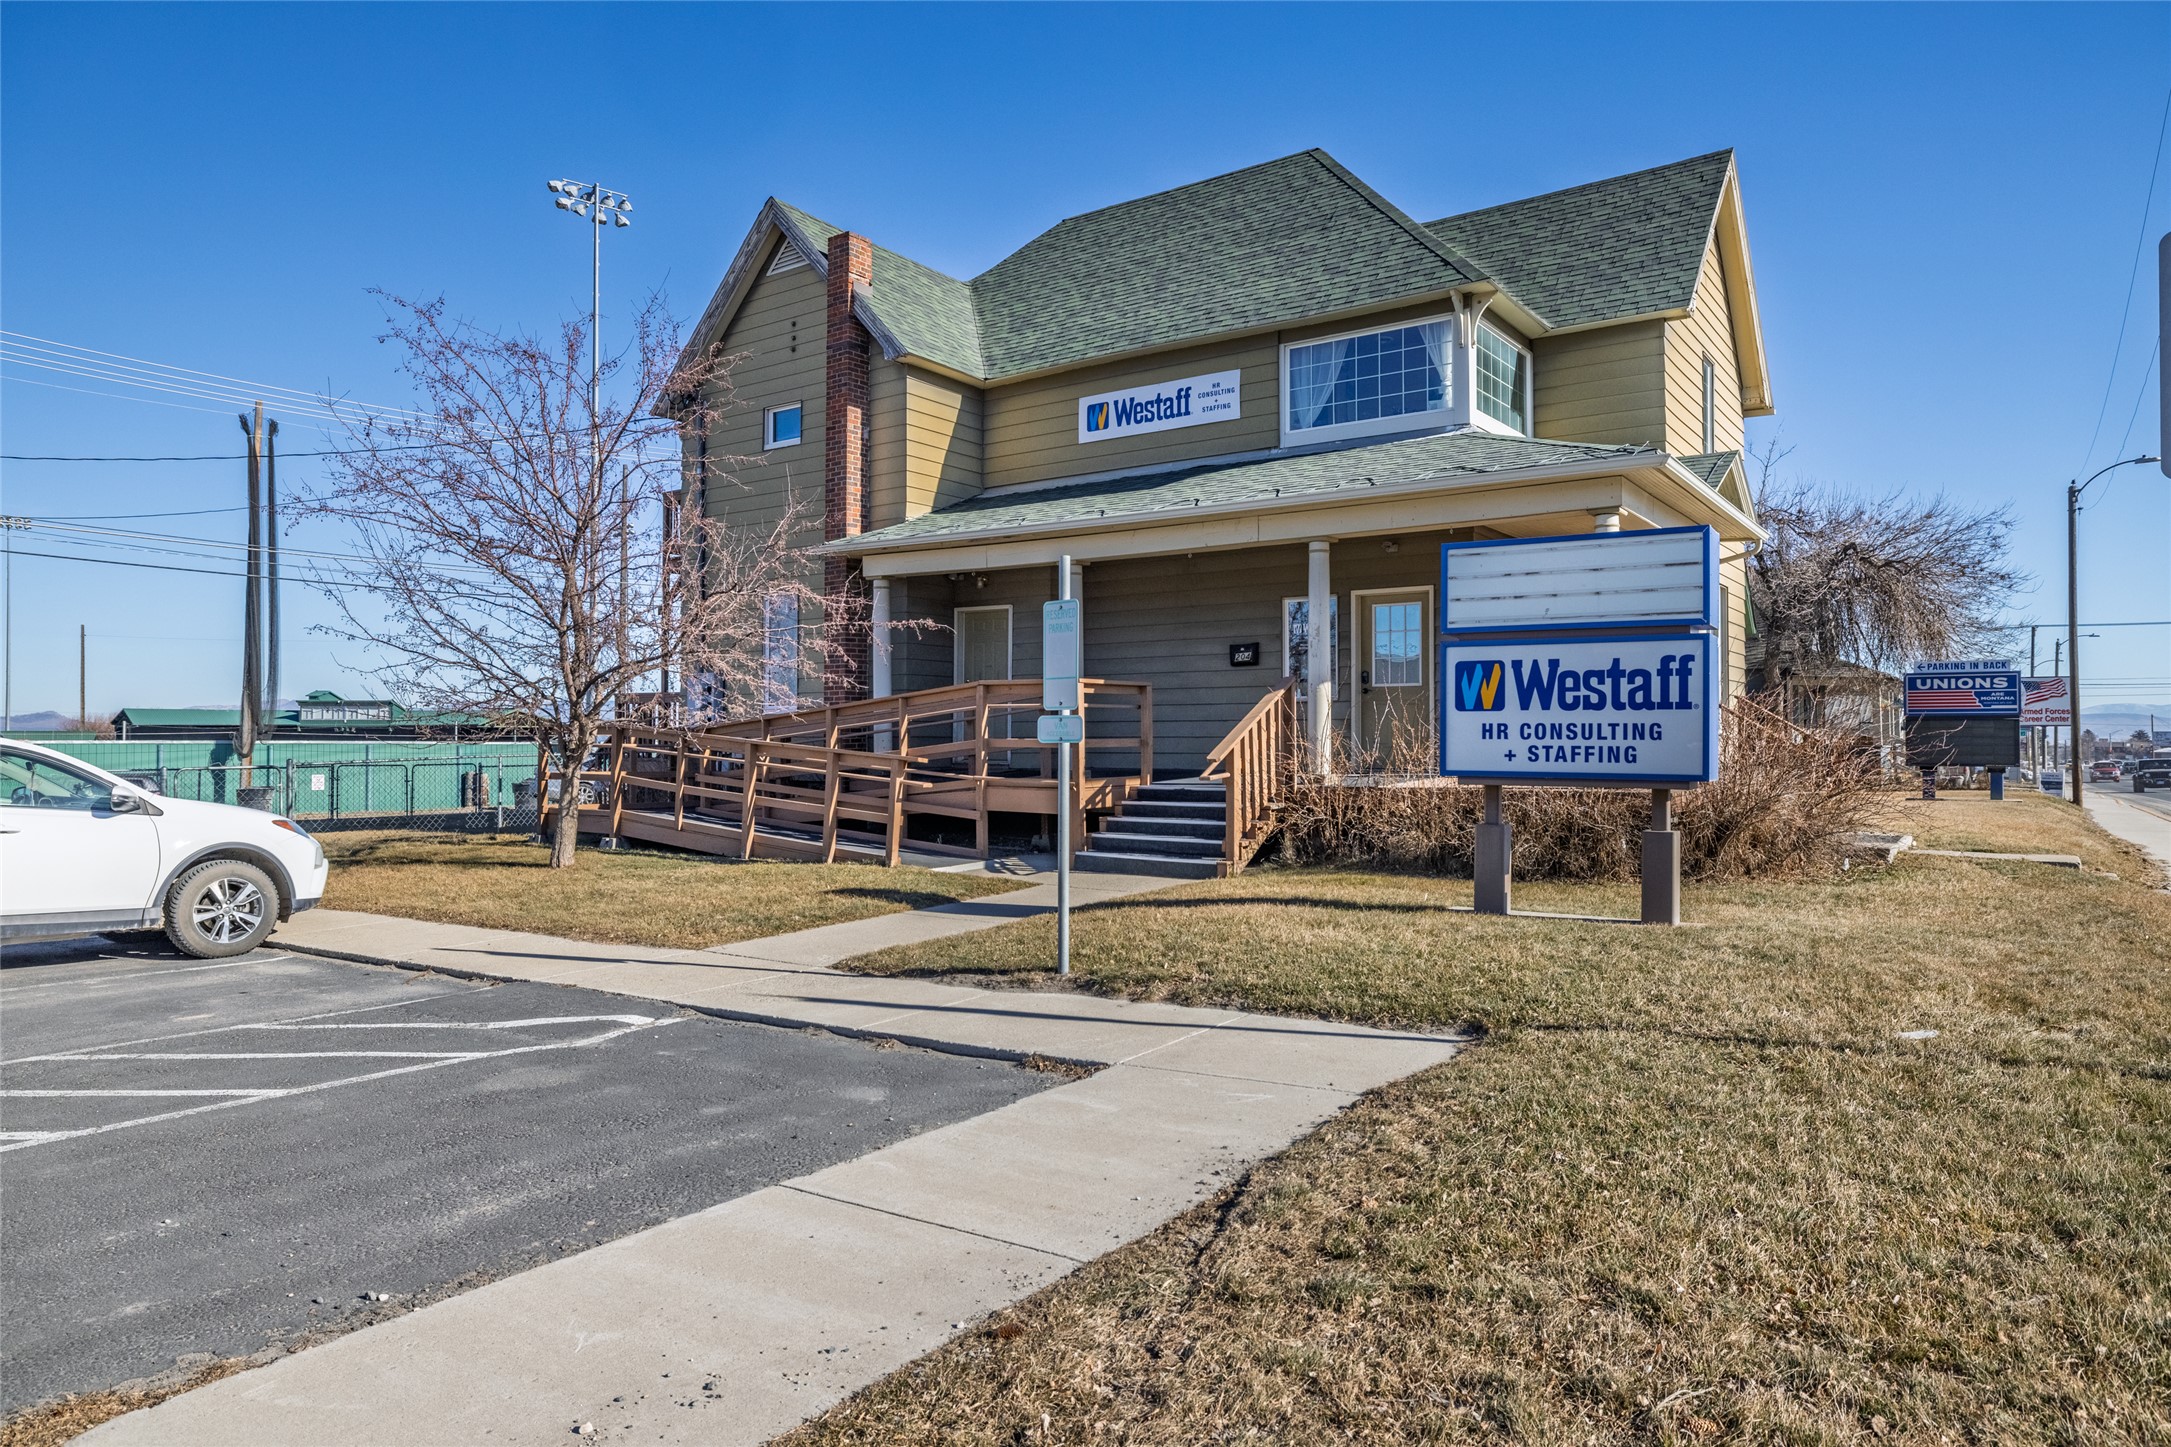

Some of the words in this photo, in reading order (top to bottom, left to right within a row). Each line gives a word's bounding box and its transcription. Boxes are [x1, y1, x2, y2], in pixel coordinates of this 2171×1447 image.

[1197, 387, 1235, 399] CONSULTING
[1113, 386, 1192, 427] Westaff
[1202, 402, 1231, 413] STAFFING
[1046, 608, 1076, 620] RESERVED
[1048, 621, 1074, 634] PARKING
[1927, 662, 1966, 671] PARKING
[1969, 662, 1979, 670] IN
[1983, 661, 2007, 670] BACK
[1511, 654, 1696, 711] Westaff
[1916, 677, 2009, 690] UNIONS
[2045, 707, 2071, 715] Forces
[2045, 715, 2070, 723] Center
[1481, 723, 1509, 740] HR
[1519, 722, 1663, 741] CONSULTING
[1527, 744, 1638, 764] STAFFING
